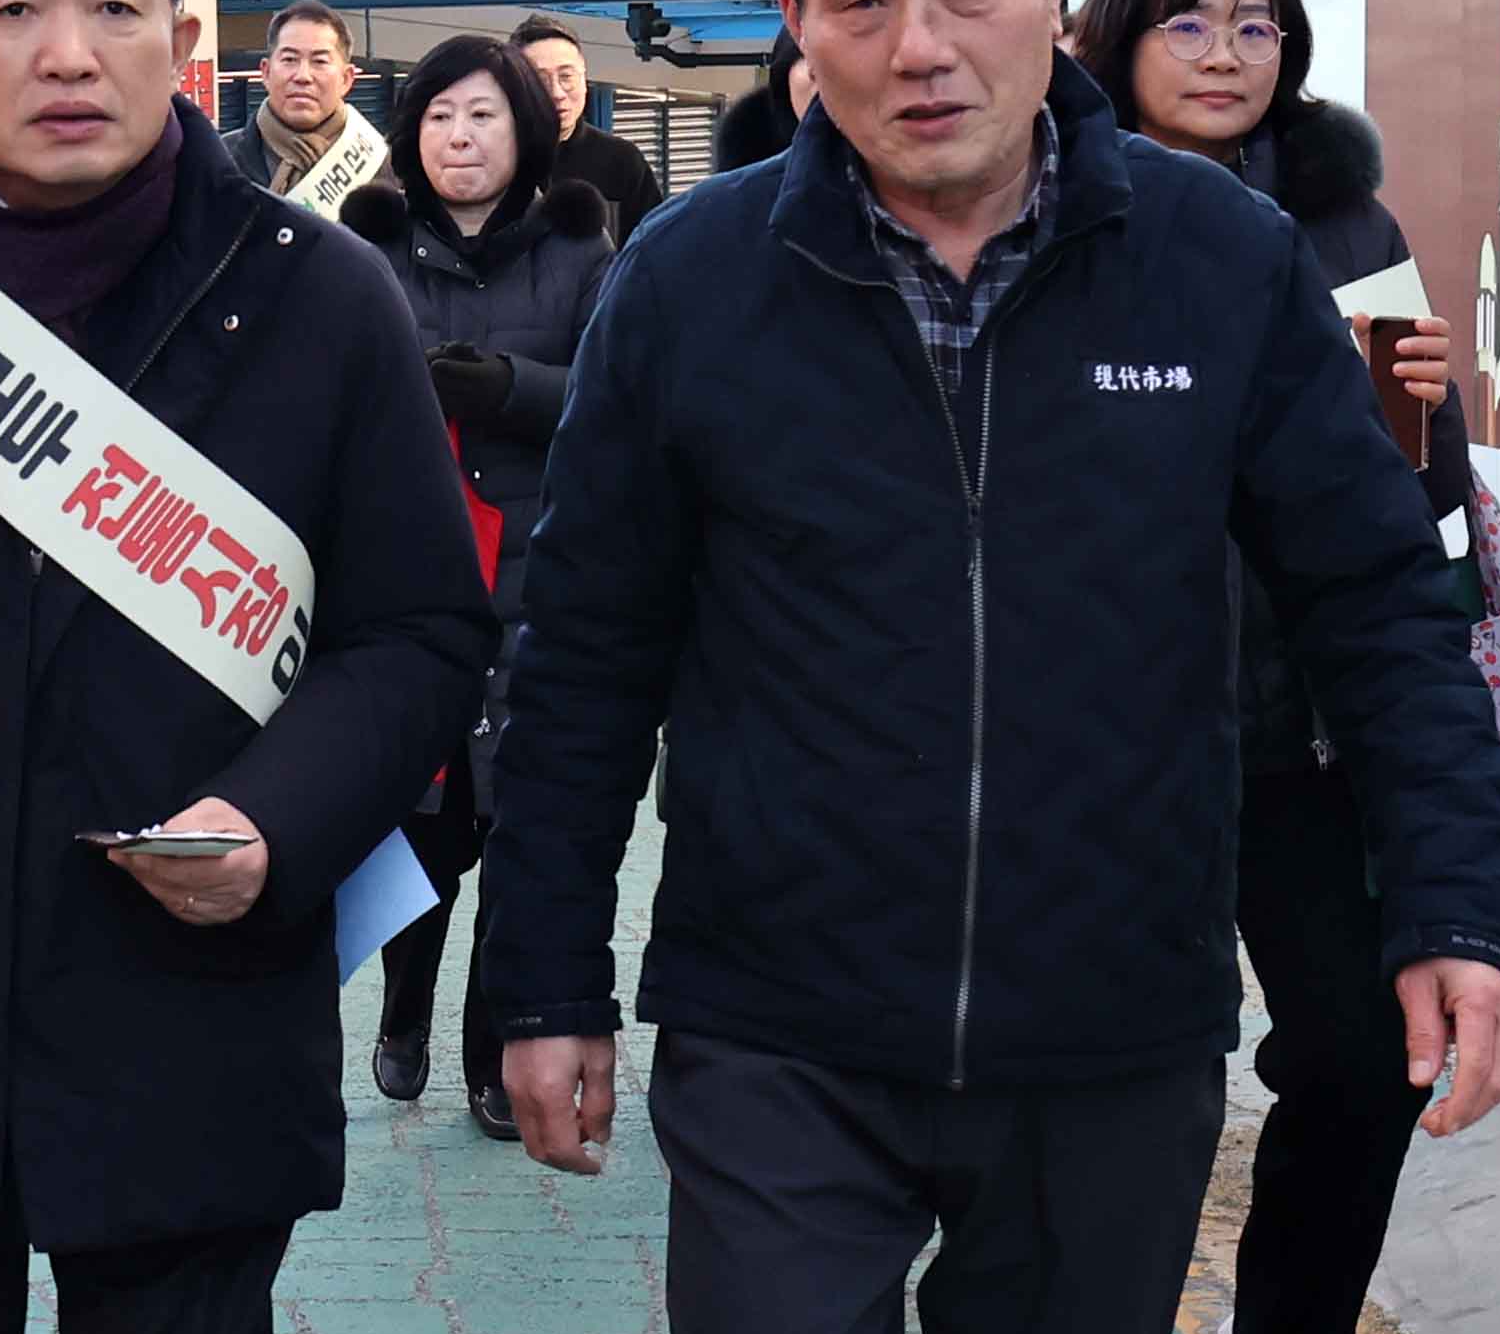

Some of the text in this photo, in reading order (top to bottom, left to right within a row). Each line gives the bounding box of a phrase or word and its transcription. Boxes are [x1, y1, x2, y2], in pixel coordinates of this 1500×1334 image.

[1094, 364, 1193, 392] 現代市場
[62, 444, 288, 656] 전통시장
